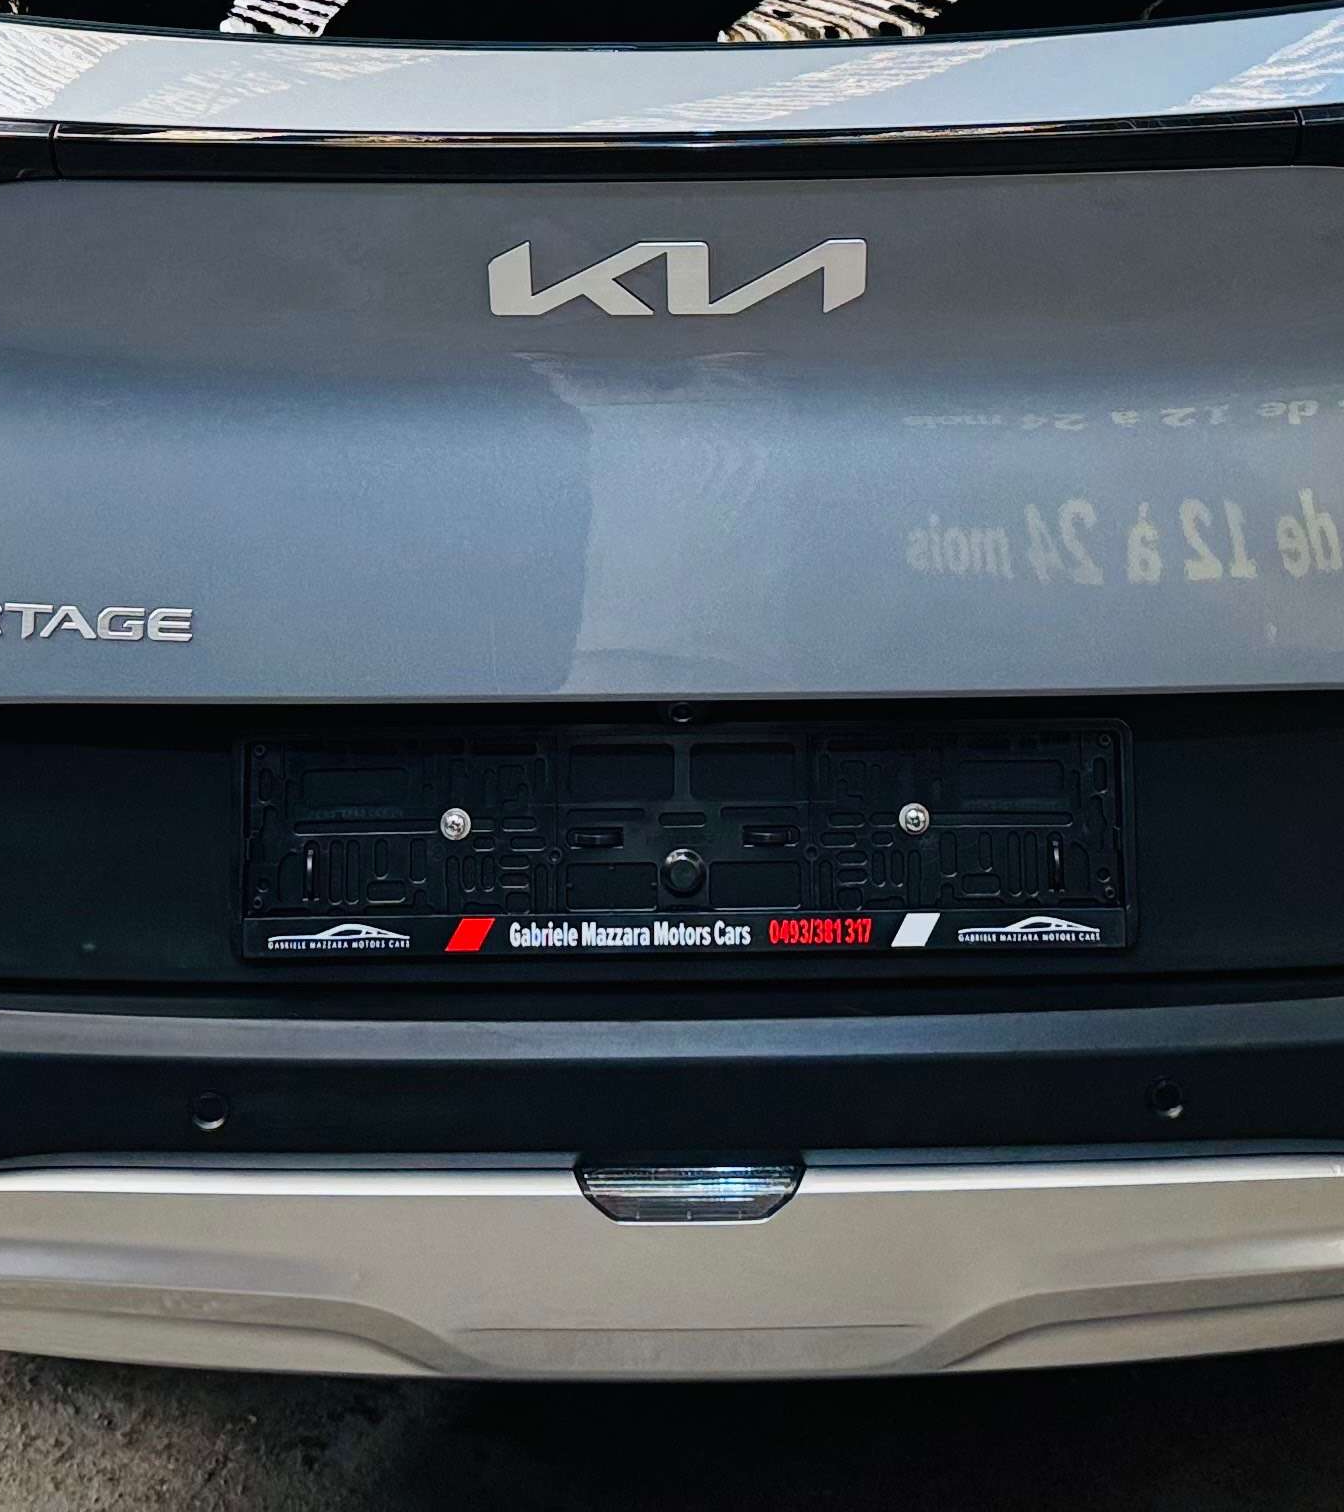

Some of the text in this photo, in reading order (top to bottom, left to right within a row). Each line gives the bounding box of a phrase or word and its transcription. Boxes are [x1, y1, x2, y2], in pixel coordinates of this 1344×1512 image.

[488, 238, 867, 316] KIA
[509, 918, 872, 947] Gabriele Mazzara Motors Cars 0493/381 317
